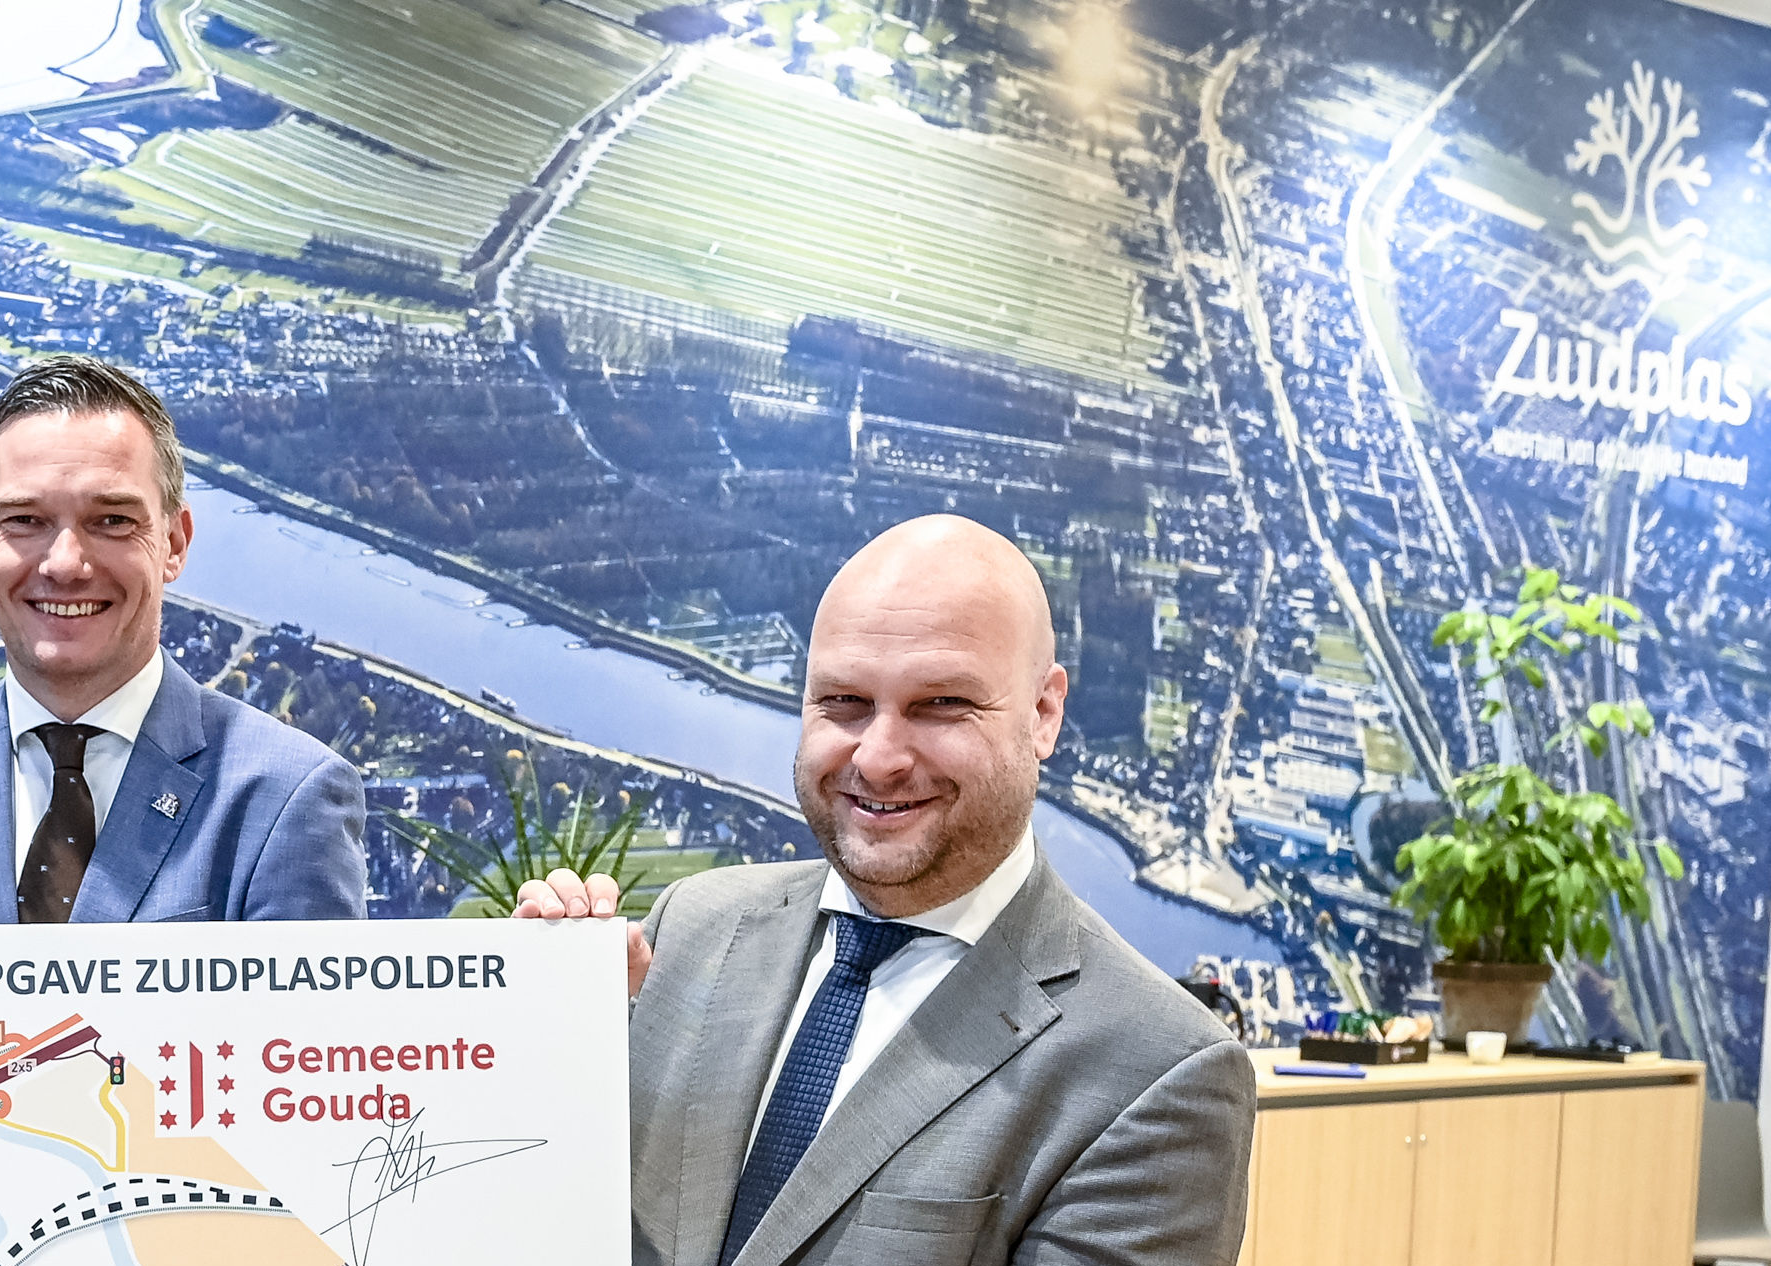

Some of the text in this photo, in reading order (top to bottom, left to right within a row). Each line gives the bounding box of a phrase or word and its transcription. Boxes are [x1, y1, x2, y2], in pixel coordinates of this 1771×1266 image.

[1493, 308, 1752, 432] Zuidplas
[135, 955, 507, 993] ZUIDPLASPOLDER
[10, 1061, 34, 1075] 2x5
[261, 1037, 496, 1074] Gemeente
[262, 1083, 412, 1123] Gouda
